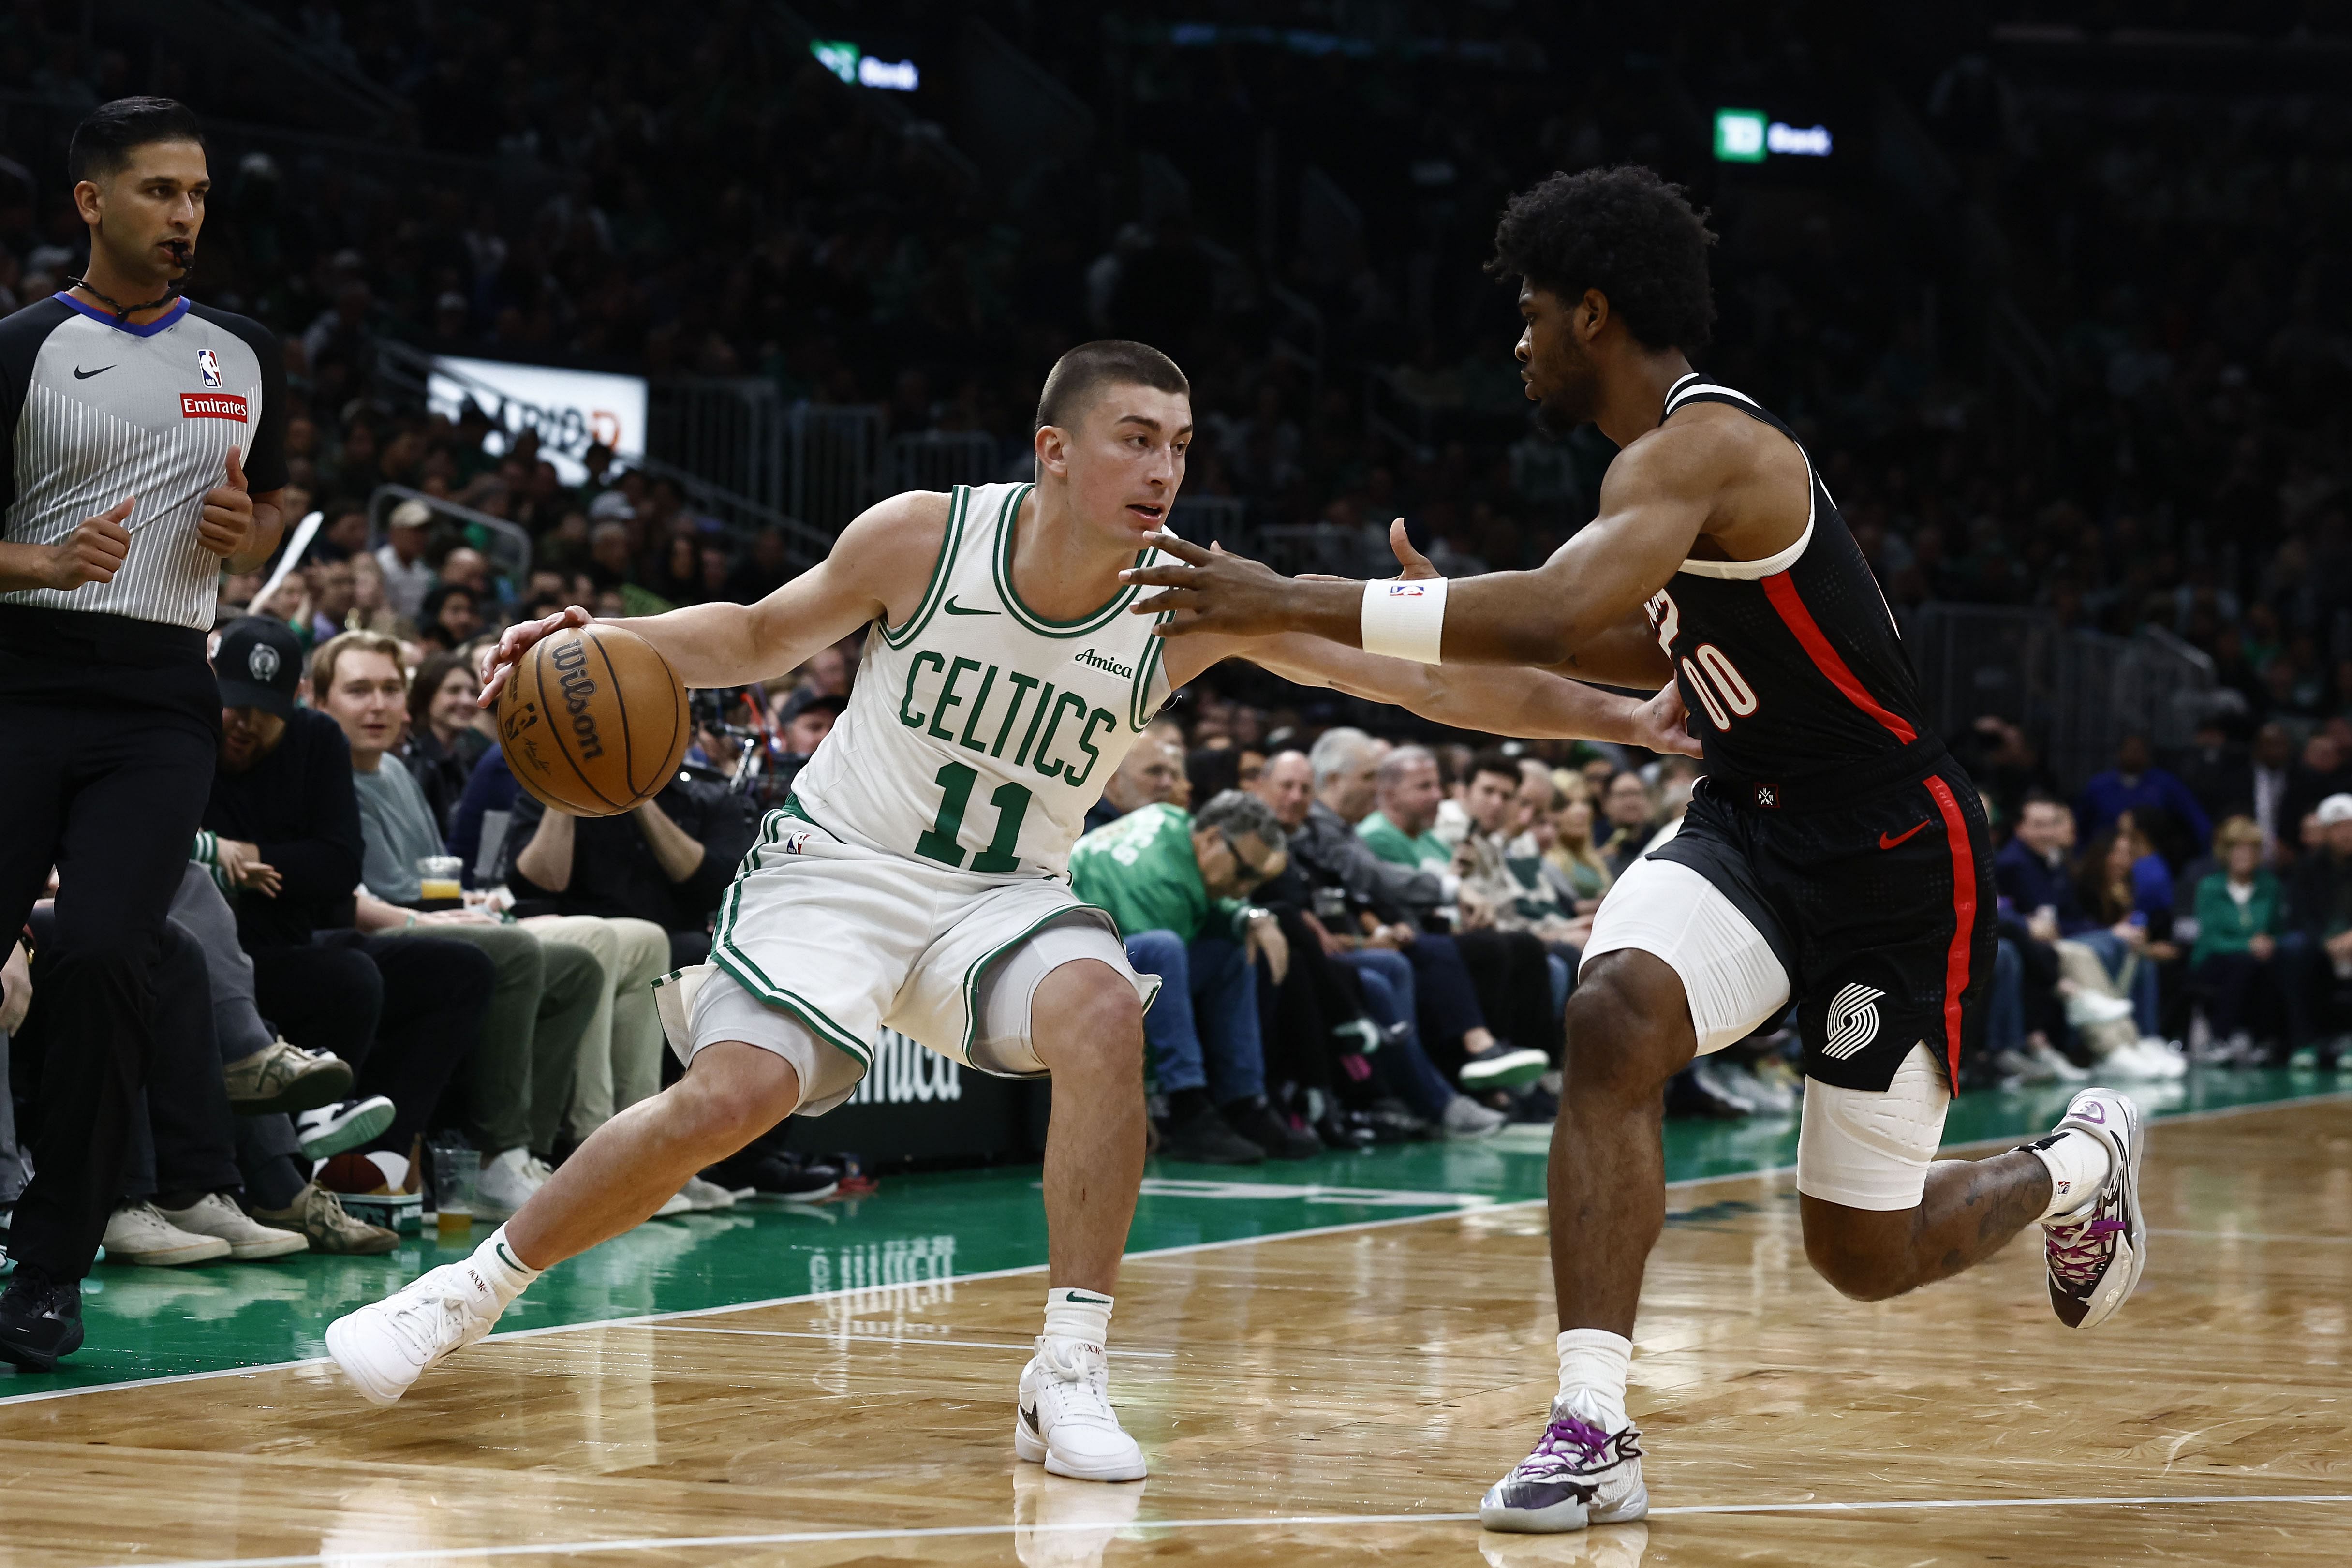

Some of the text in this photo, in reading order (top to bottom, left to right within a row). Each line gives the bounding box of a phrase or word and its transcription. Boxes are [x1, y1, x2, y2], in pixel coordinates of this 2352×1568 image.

[183, 398, 246, 416] Emirates
[1075, 649, 1133, 679] Amica
[1681, 642, 1759, 732] 00
[552, 637, 604, 761] Wilson
[899, 650, 1117, 787] CELTICS
[914, 761, 1033, 872] 11
[468, 1269, 488, 1292] BOOK
[1080, 1343, 1102, 1355] OOK
